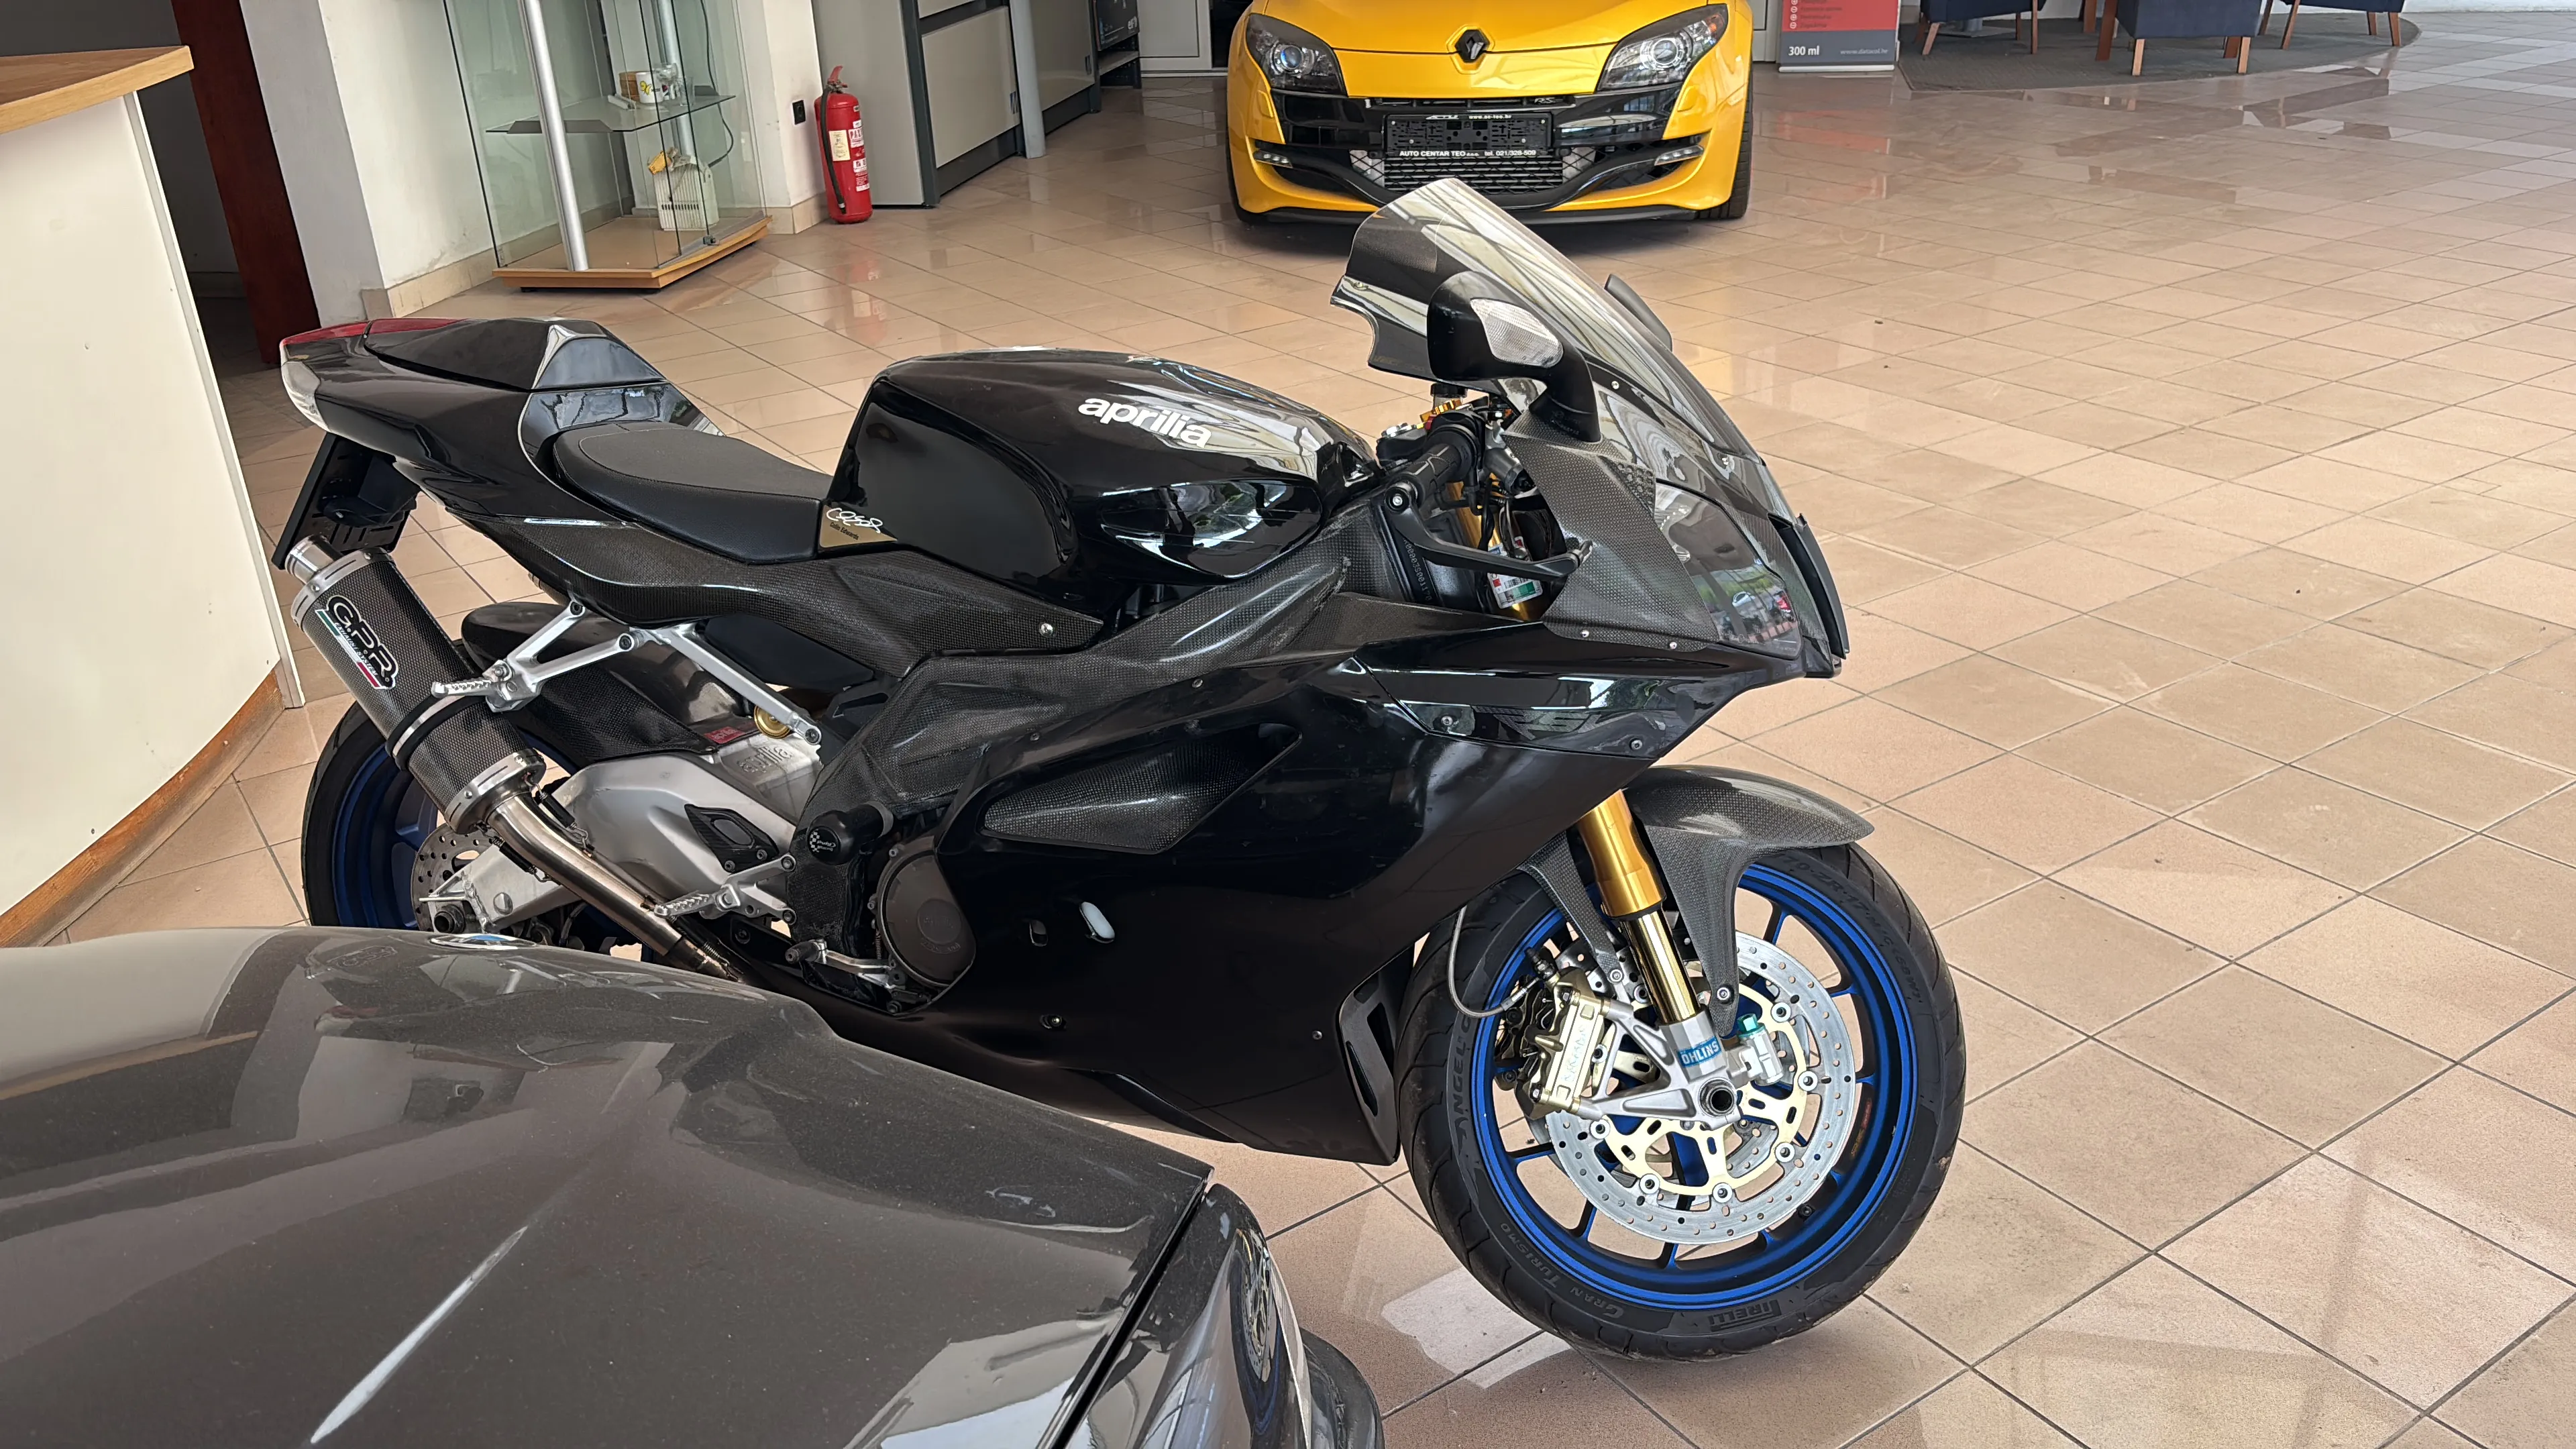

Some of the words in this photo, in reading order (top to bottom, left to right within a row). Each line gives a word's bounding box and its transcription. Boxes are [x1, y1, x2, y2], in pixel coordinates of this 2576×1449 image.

[1788, 46, 1805, 56] 300
[1808, 45, 1820, 56] ml
[1078, 398, 1212, 449] aprilia
[841, 527, 859, 541] Edwards
[333, 621, 358, 649] EXHAUST
[356, 649, 379, 677] SYSTEM
[1680, 1040, 1719, 1065] ÖHLINS
[1500, 1223, 1562, 1288] TURISMO
[1570, 1286, 1625, 1319] GRAN
[1707, 1299, 1782, 1332] PIRELLI
